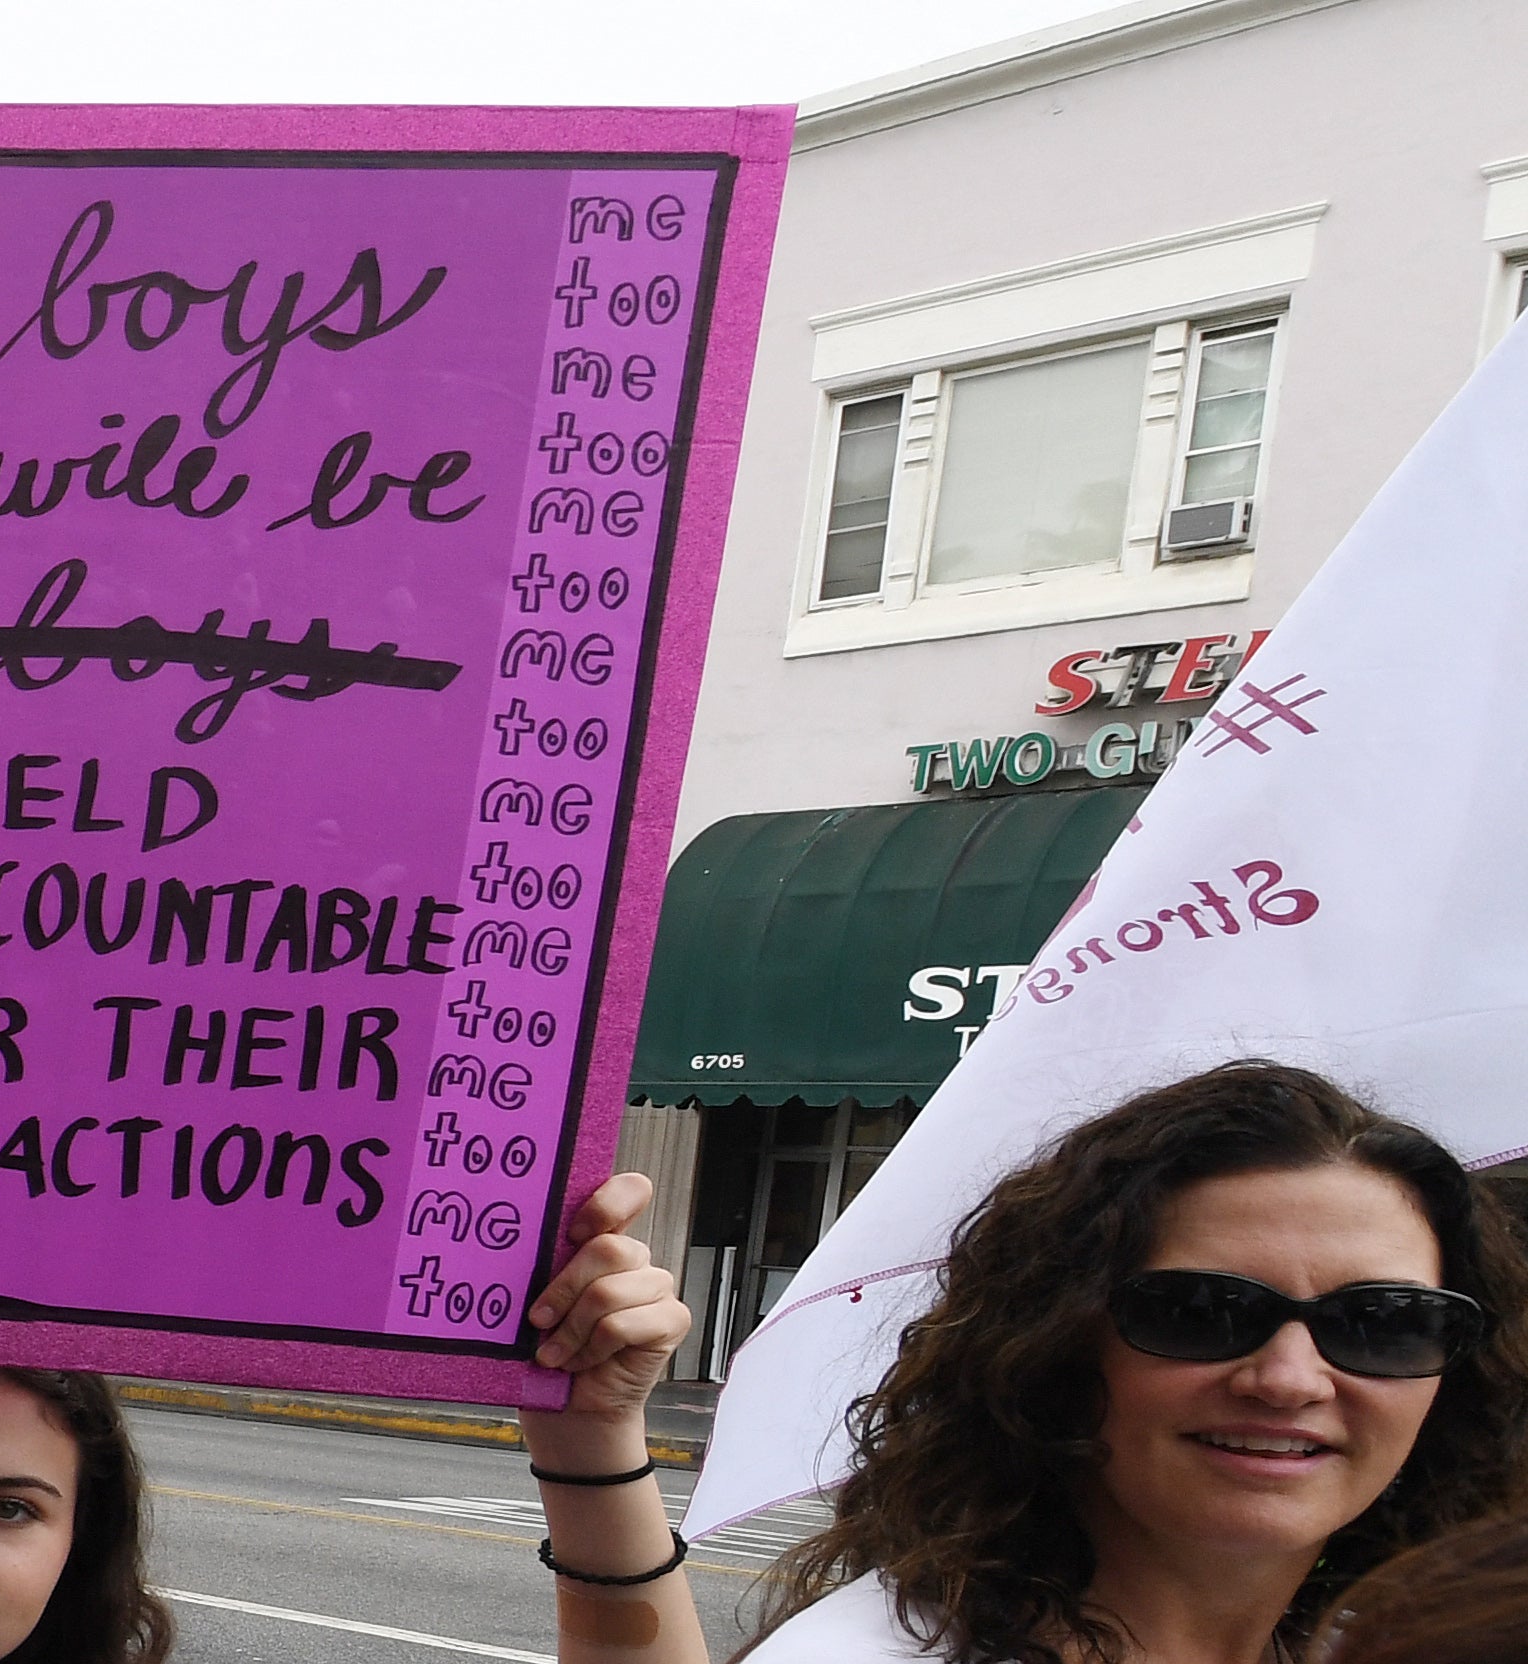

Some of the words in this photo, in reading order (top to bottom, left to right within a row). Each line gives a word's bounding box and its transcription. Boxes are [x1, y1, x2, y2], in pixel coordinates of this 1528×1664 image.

[570, 195, 685, 243] me
[555, 257, 680, 328] too
[552, 348, 656, 401] me
[539, 412, 670, 476] too
[267, 432, 485, 530] be
[529, 488, 643, 537] me
[513, 554, 628, 612] too
[501, 629, 614, 685] me
[494, 698, 607, 760] too
[906, 732, 1056, 794] TWO
[1085, 717, 1202, 779] GU
[480, 778, 592, 835] me
[470, 842, 581, 910] too
[463, 921, 571, 975] me
[448, 980, 556, 1047] too
[94, 997, 398, 1101] THEIR
[691, 1054, 745, 1071] 6705
[428, 1054, 532, 1110] me
[424, 1112, 536, 1178] too
[408, 1190, 520, 1250] me
[400, 1256, 511, 1329] too
